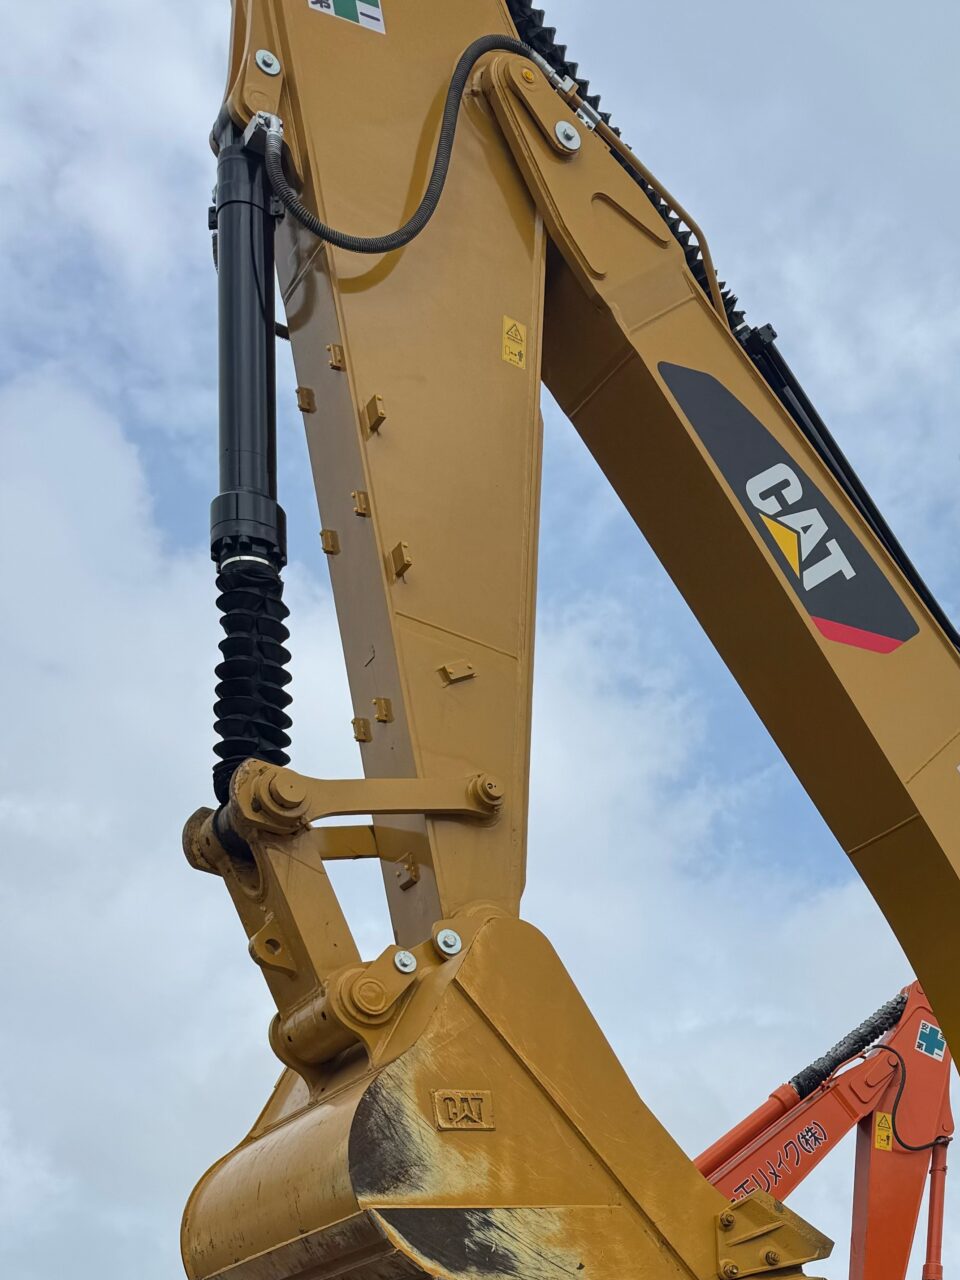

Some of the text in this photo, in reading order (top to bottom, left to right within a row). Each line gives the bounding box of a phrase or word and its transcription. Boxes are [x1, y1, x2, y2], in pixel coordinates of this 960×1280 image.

[746, 462, 857, 592] CAT
[730, 1121, 828, 1204] 正リメイク(株)
